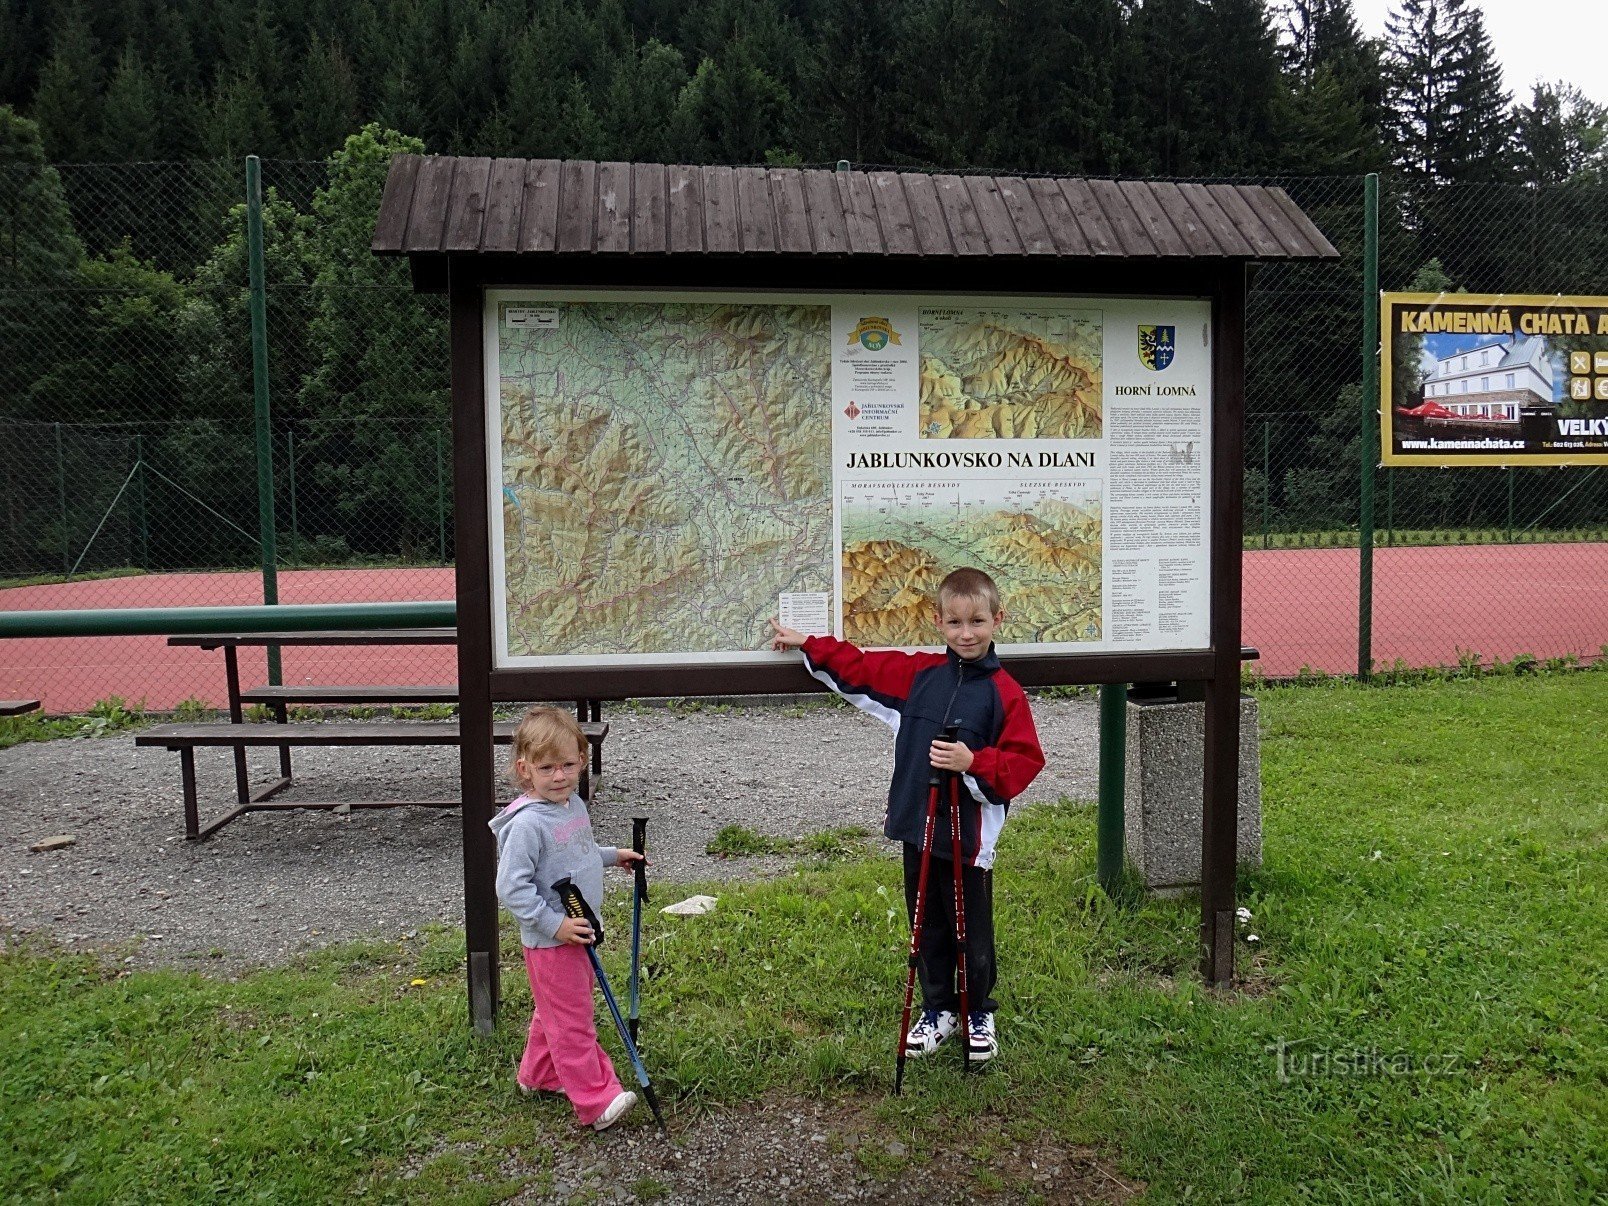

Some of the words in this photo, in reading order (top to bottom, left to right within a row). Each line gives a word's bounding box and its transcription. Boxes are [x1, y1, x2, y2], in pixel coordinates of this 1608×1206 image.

[1401, 309, 1513, 334] KAMENNÁ
[1519, 313, 1590, 335] CHATA
[1115, 384, 1151, 396] HORNÍ
[1156, 384, 1196, 396] LOMNÁ
[1402, 437, 1525, 449] www.kamennachata.cz
[846, 452, 1002, 468] JABLUNKOVSKO
[1006, 452, 1033, 468] NA
[1038, 452, 1096, 468] DLANI
